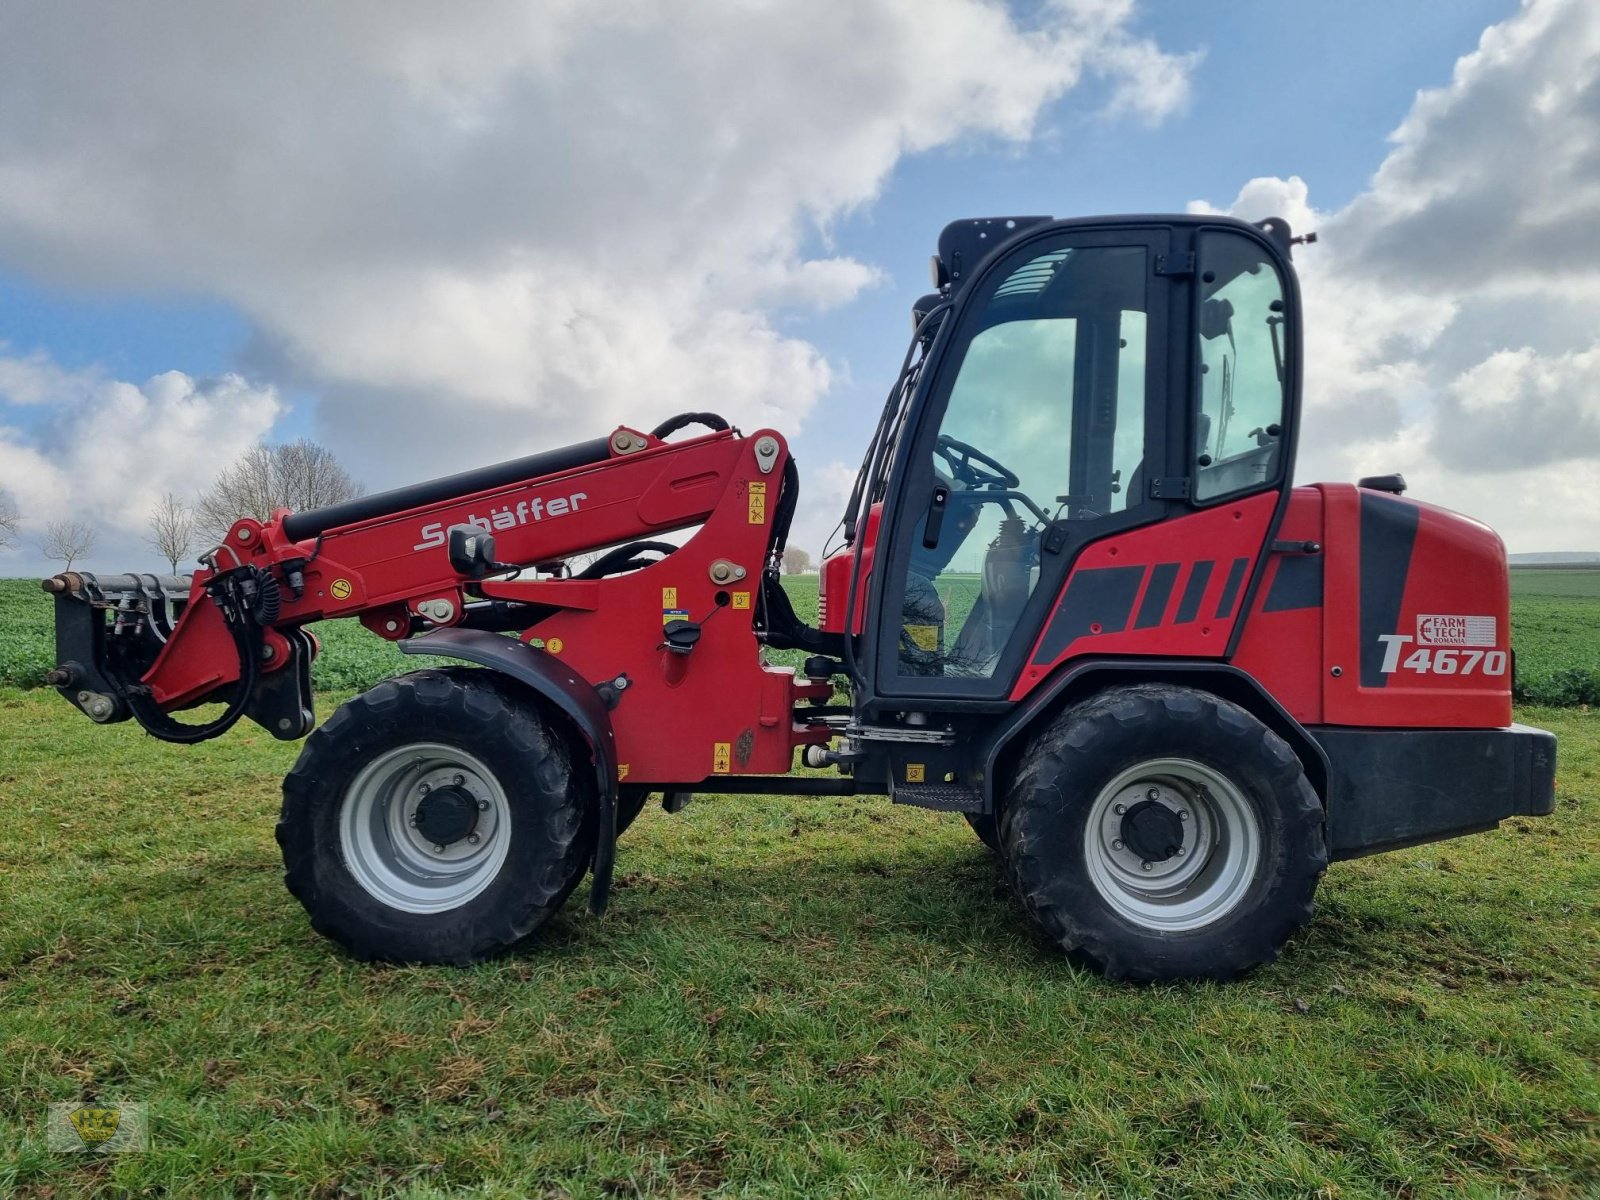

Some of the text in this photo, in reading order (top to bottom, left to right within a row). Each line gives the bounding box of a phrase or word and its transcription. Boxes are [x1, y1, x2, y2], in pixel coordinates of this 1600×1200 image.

[413, 492, 588, 551] Shäffer
[1433, 617, 1466, 628] FARM
[1434, 628, 1466, 638] TECH
